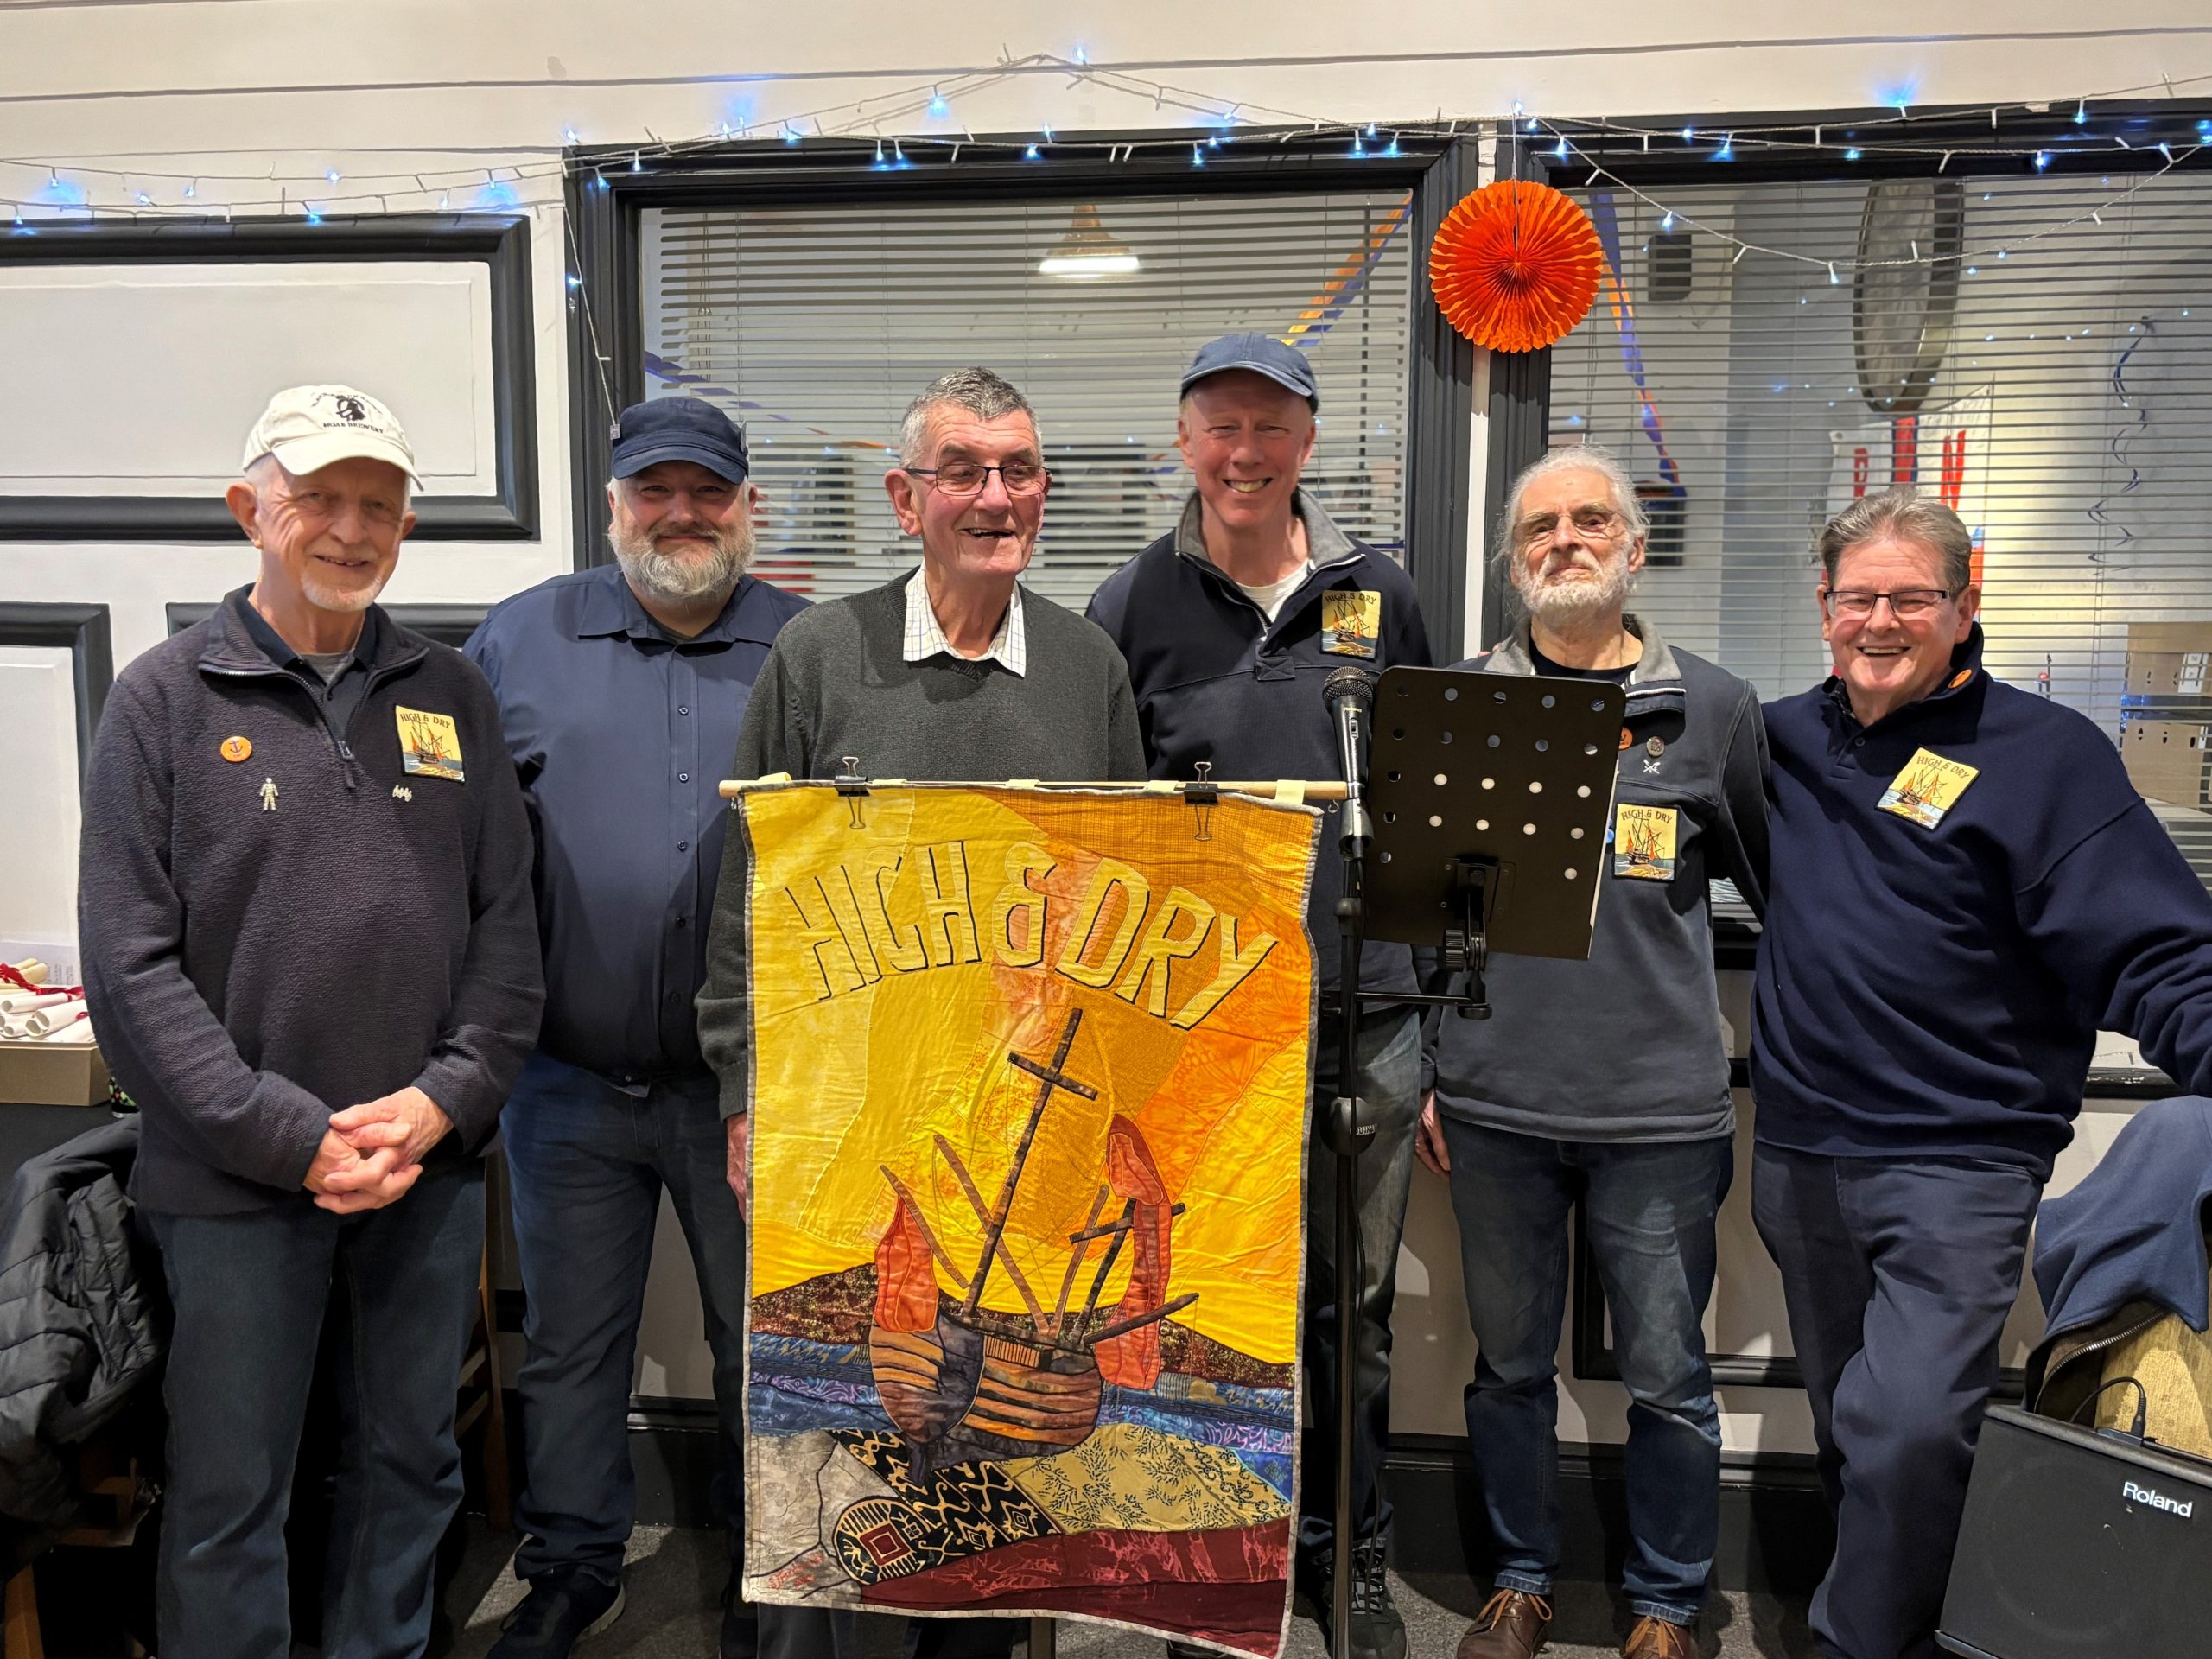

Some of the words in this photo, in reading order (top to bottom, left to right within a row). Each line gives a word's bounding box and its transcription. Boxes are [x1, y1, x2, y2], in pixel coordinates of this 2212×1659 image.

[1325, 592, 1347, 603] HIGH
[1358, 592, 1376, 605] DRY
[400, 713, 421, 723] HIGH
[433, 716, 451, 729] DRY
[1916, 756, 1942, 768] HIGH
[1950, 766, 1970, 779] DRY
[1621, 809, 1643, 821] HIGH
[1656, 811, 1673, 824] DRY
[783, 840, 983, 1001] HIGH
[1052, 857, 1281, 1032] DRY
[2122, 1480, 2194, 1518] Roland
